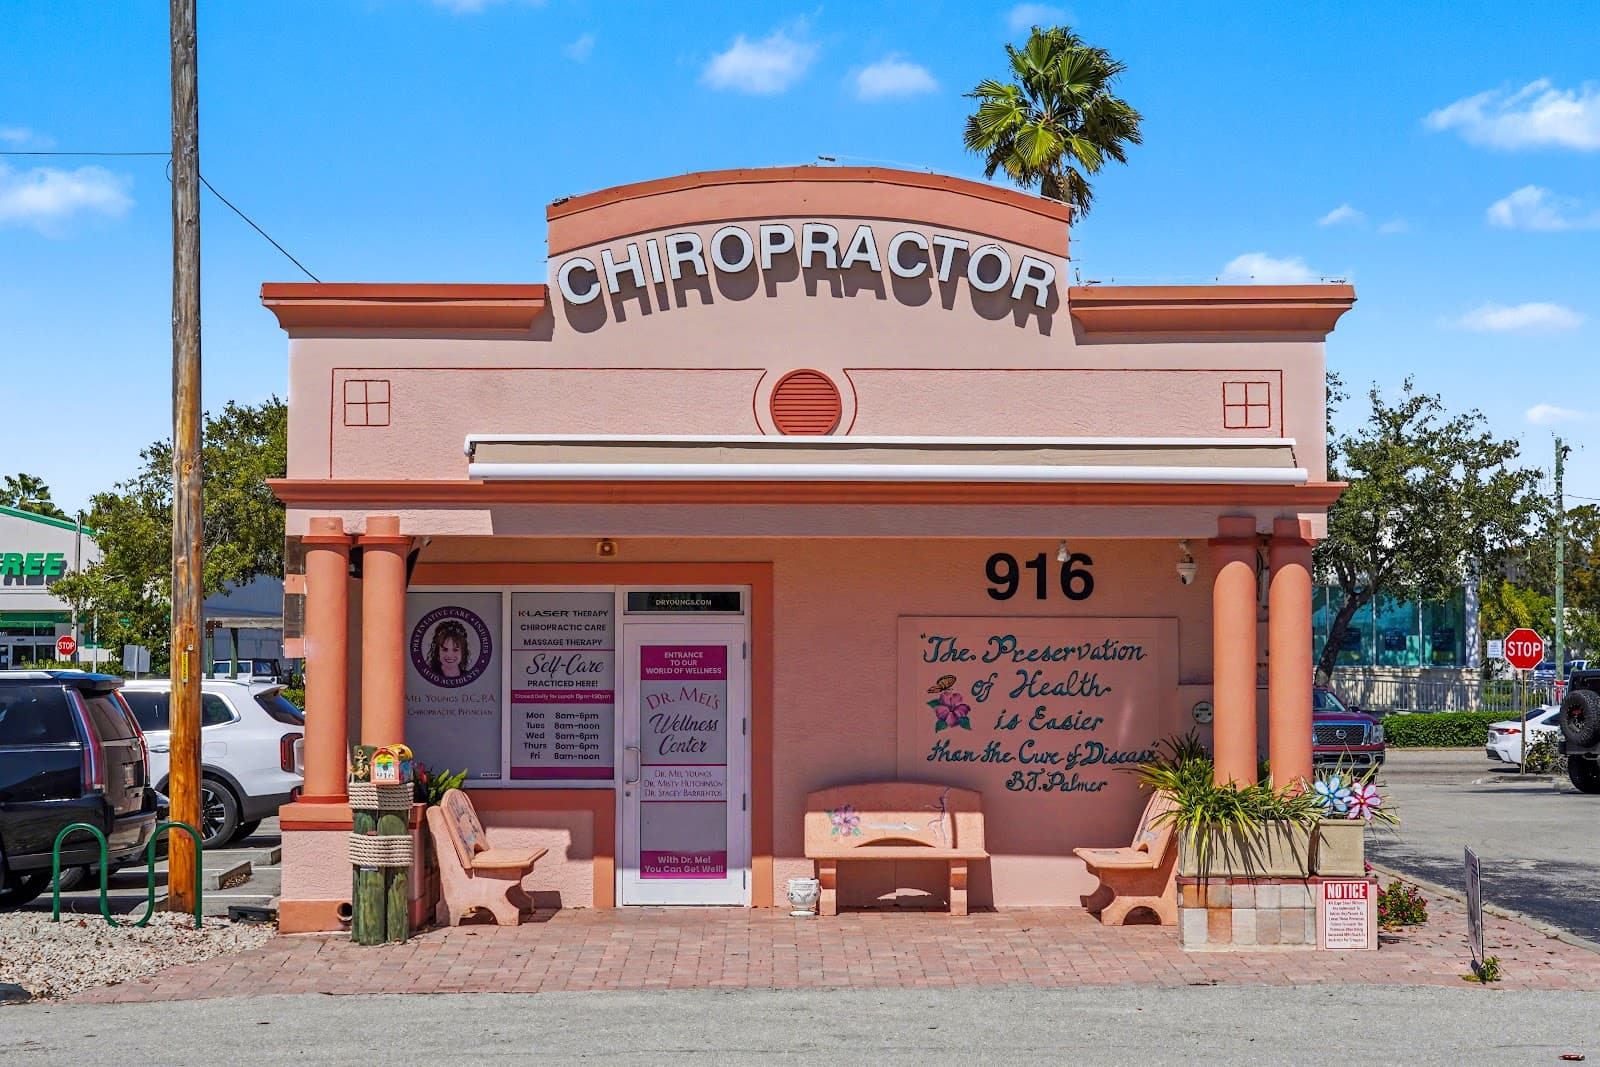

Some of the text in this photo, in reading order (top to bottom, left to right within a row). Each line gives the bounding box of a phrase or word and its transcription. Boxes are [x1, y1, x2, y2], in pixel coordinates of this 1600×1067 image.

[557, 222, 1056, 308] CHIROPRACTOR
[0, 552, 64, 575] REE
[985, 552, 1094, 600] 916
[449, 609, 470, 619] CARE
[58, 641, 75, 650] STOP
[664, 651, 704, 659] ENTRANCE
[982, 634, 1147, 663] Preservation
[1507, 641, 1541, 657] STOP
[526, 653, 604, 679] Self-Care
[971, 669, 1112, 702] of Health
[649, 713, 719, 733] Wellness
[994, 705, 1104, 731] is Easier
[659, 734, 707, 756] Center
[927, 739, 981, 762] than
[981, 740, 1016, 763] the
[1018, 739, 1064, 764] Cure
[1065, 743, 1082, 770] of
[1043, 770, 1108, 792] Palmer
[645, 865, 661, 873] You
[663, 865, 682, 873] Can
[684, 865, 699, 873] Get
[657, 856, 711, 864] With Dr. Mel
[1327, 883, 1365, 898] NOTICE
